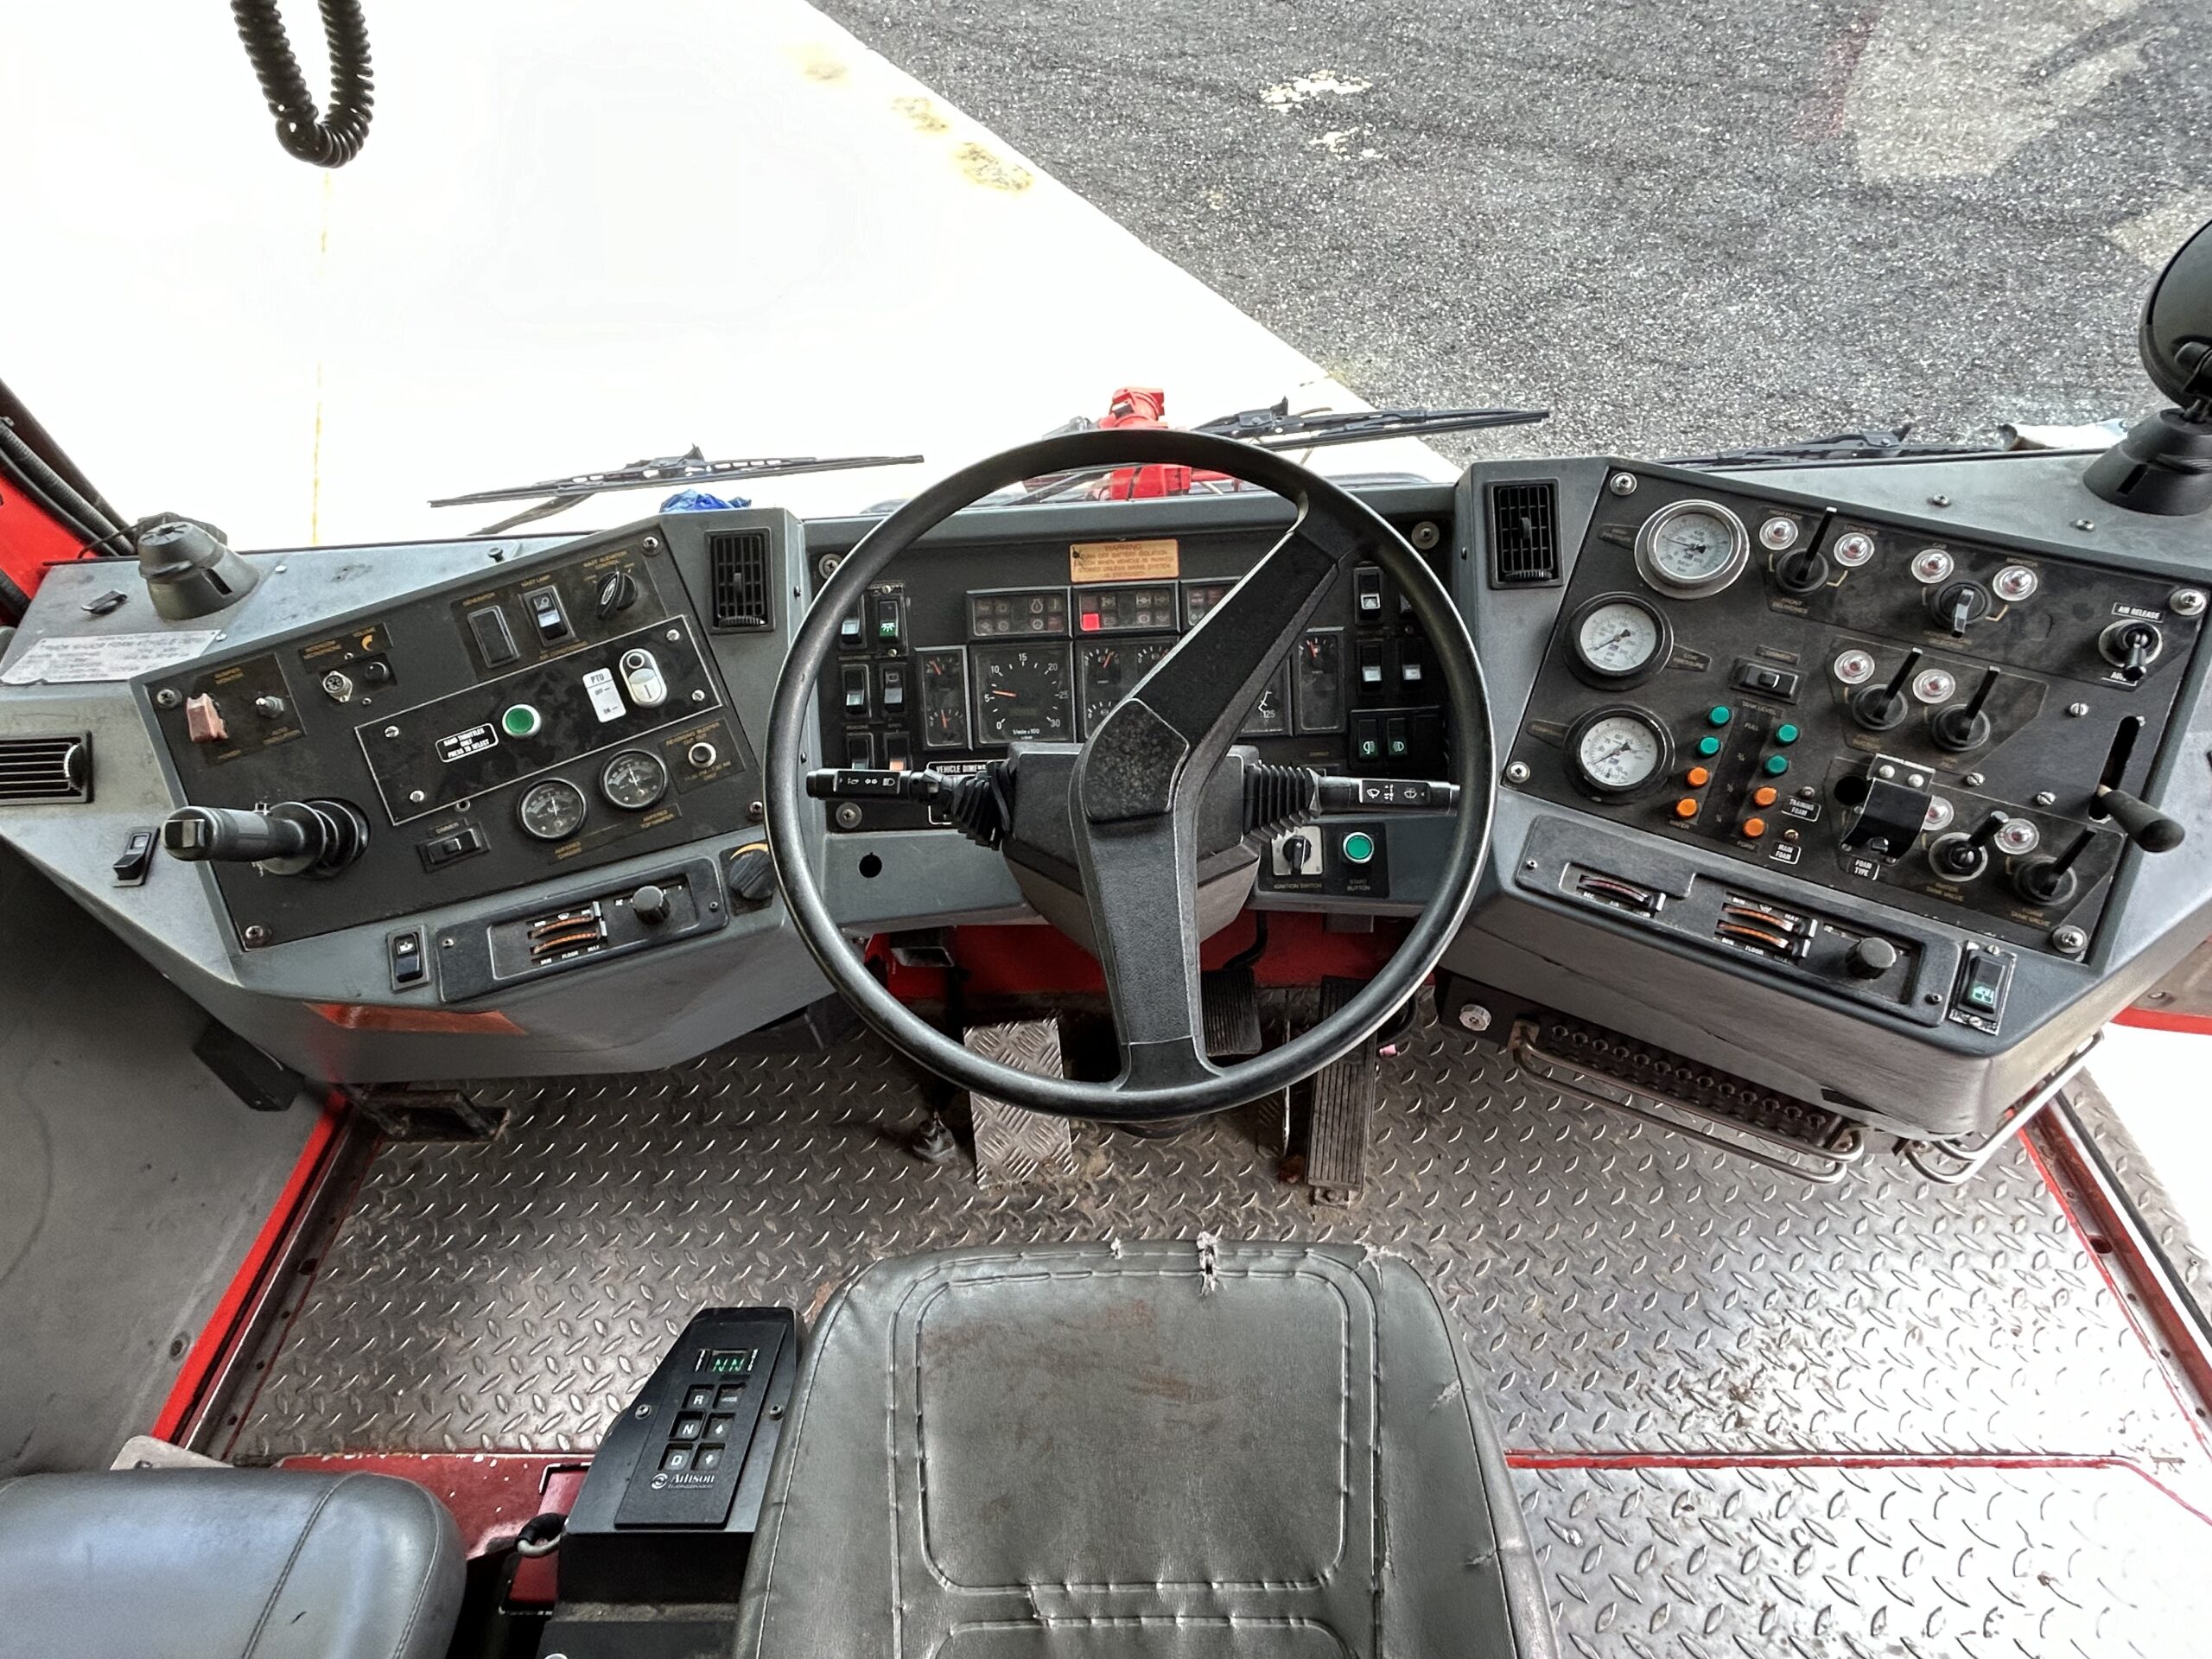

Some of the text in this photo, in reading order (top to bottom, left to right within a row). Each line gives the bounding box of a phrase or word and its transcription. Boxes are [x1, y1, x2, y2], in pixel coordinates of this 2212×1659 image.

[2130, 607, 2160, 620] RELEASE
[1018, 652, 1027, 662] 15
[990, 664, 1000, 674] 10
[1048, 663, 1058, 671] 20
[590, 673, 604, 683] PTO
[984, 694, 990, 702] 5
[996, 721, 1002, 730] 0
[1051, 719, 1061, 728] 30
[1789, 798, 1815, 811] TRAINING
[1791, 807, 1808, 817] FOAM
[1778, 844, 1794, 854] MAIN
[1775, 850, 1792, 861] FOAM
[1854, 860, 1872, 869] FOAM
[1854, 867, 1869, 877] TYPE
[562, 950, 579, 959] FLOOR
[1745, 945, 1764, 956] FLOOR
[693, 1395, 703, 1405] R
[683, 1424, 694, 1434] N
[671, 1454, 683, 1465] D
